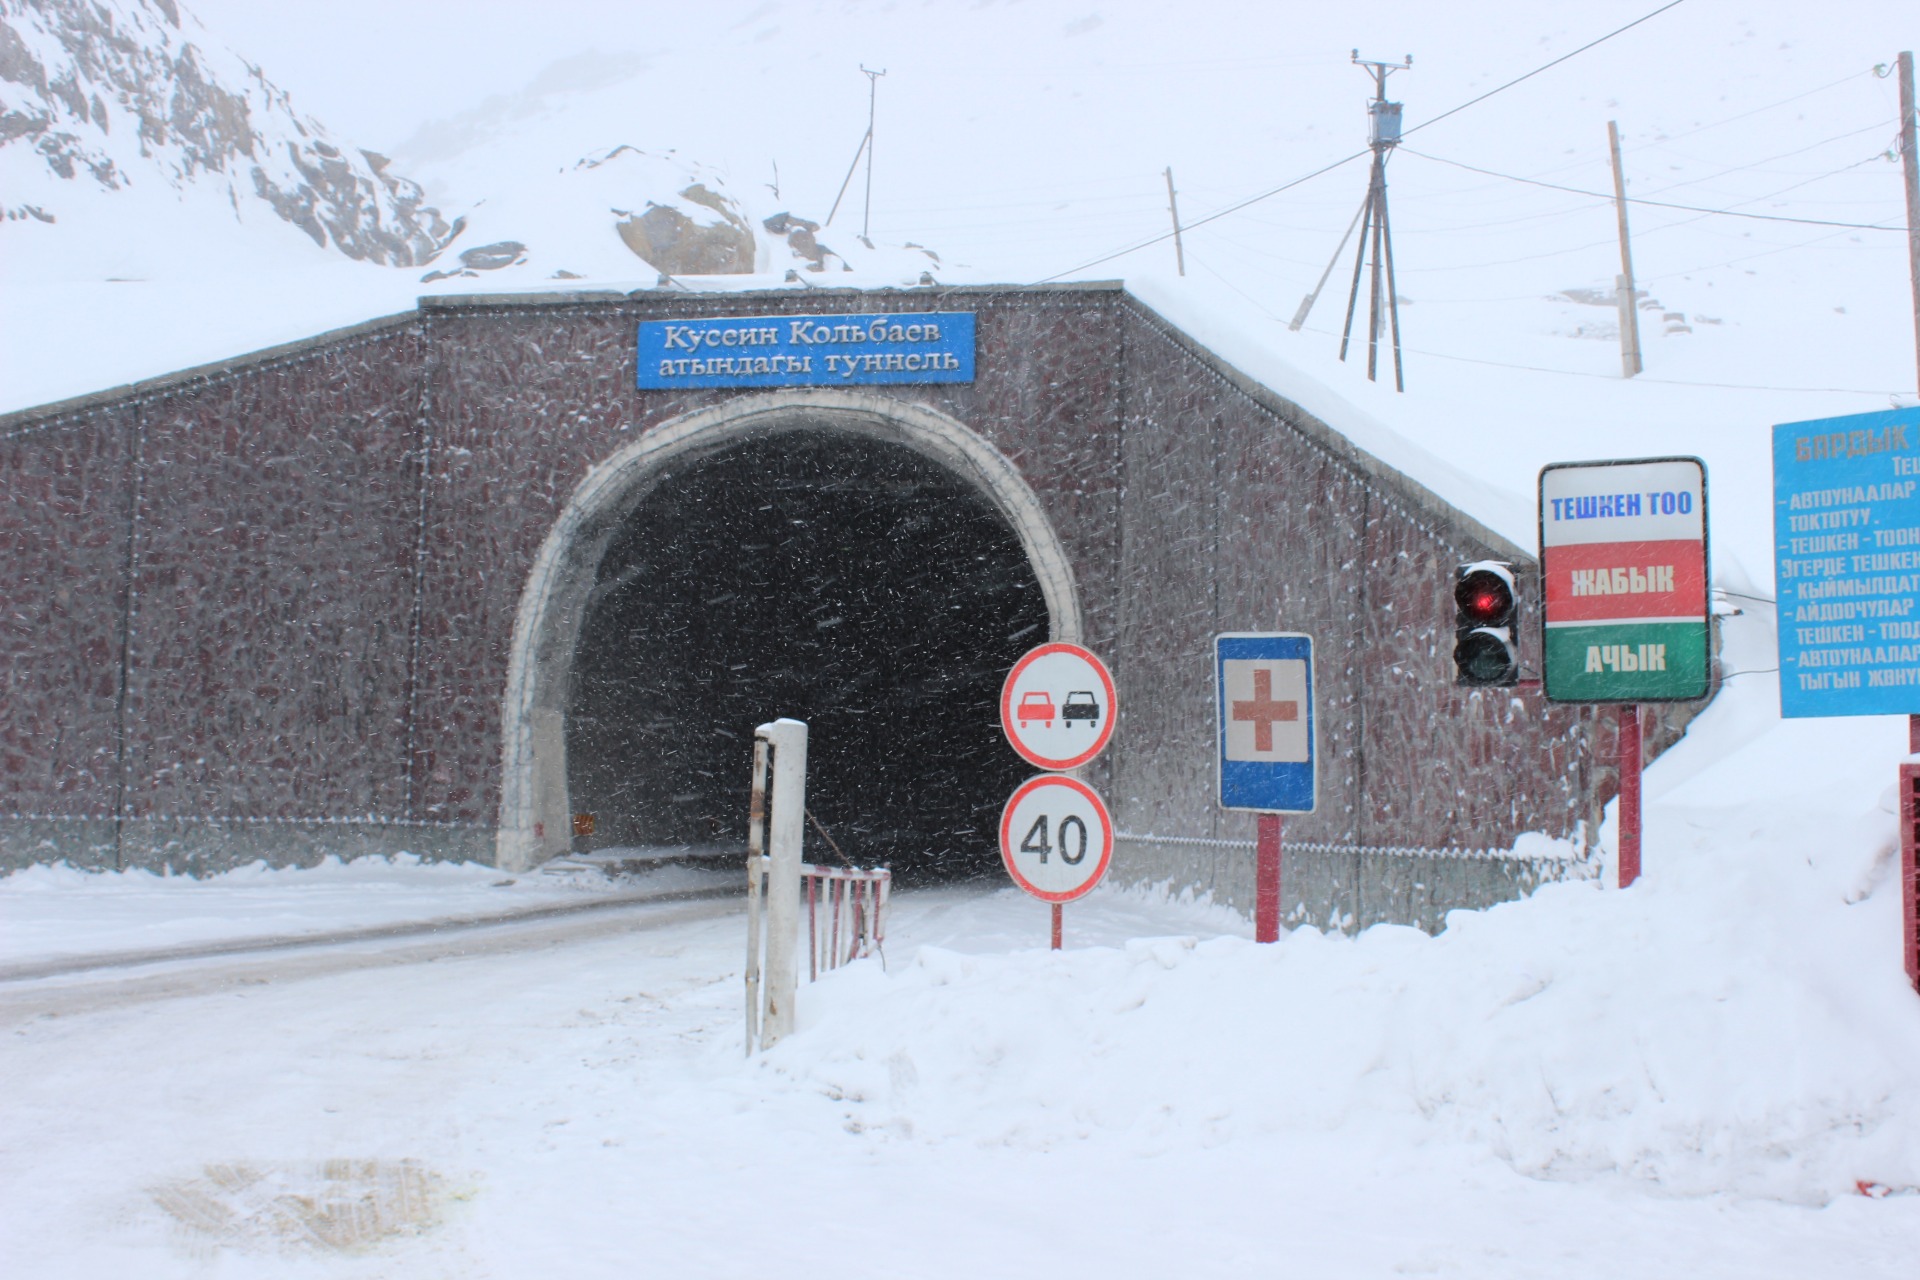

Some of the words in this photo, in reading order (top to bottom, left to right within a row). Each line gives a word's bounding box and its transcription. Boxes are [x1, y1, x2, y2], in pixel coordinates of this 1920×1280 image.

[664, 325, 779, 353] Кусеин
[789, 318, 941, 345] Кольбаев
[659, 355, 812, 376] атындагы
[824, 352, 960, 378] туннель
[1795, 424, 1909, 462] БАРДЫК
[1550, 493, 1641, 522] ТЕШКЕН
[1647, 490, 1693, 516] ТОО
[1571, 564, 1675, 597] ЖАБЫК
[1796, 624, 1865, 646] ТЕШКЕН
[1584, 644, 1667, 674] АЧЫК
[1797, 670, 1861, 691] ТЫГЫН
[1019, 813, 1088, 866] 40
